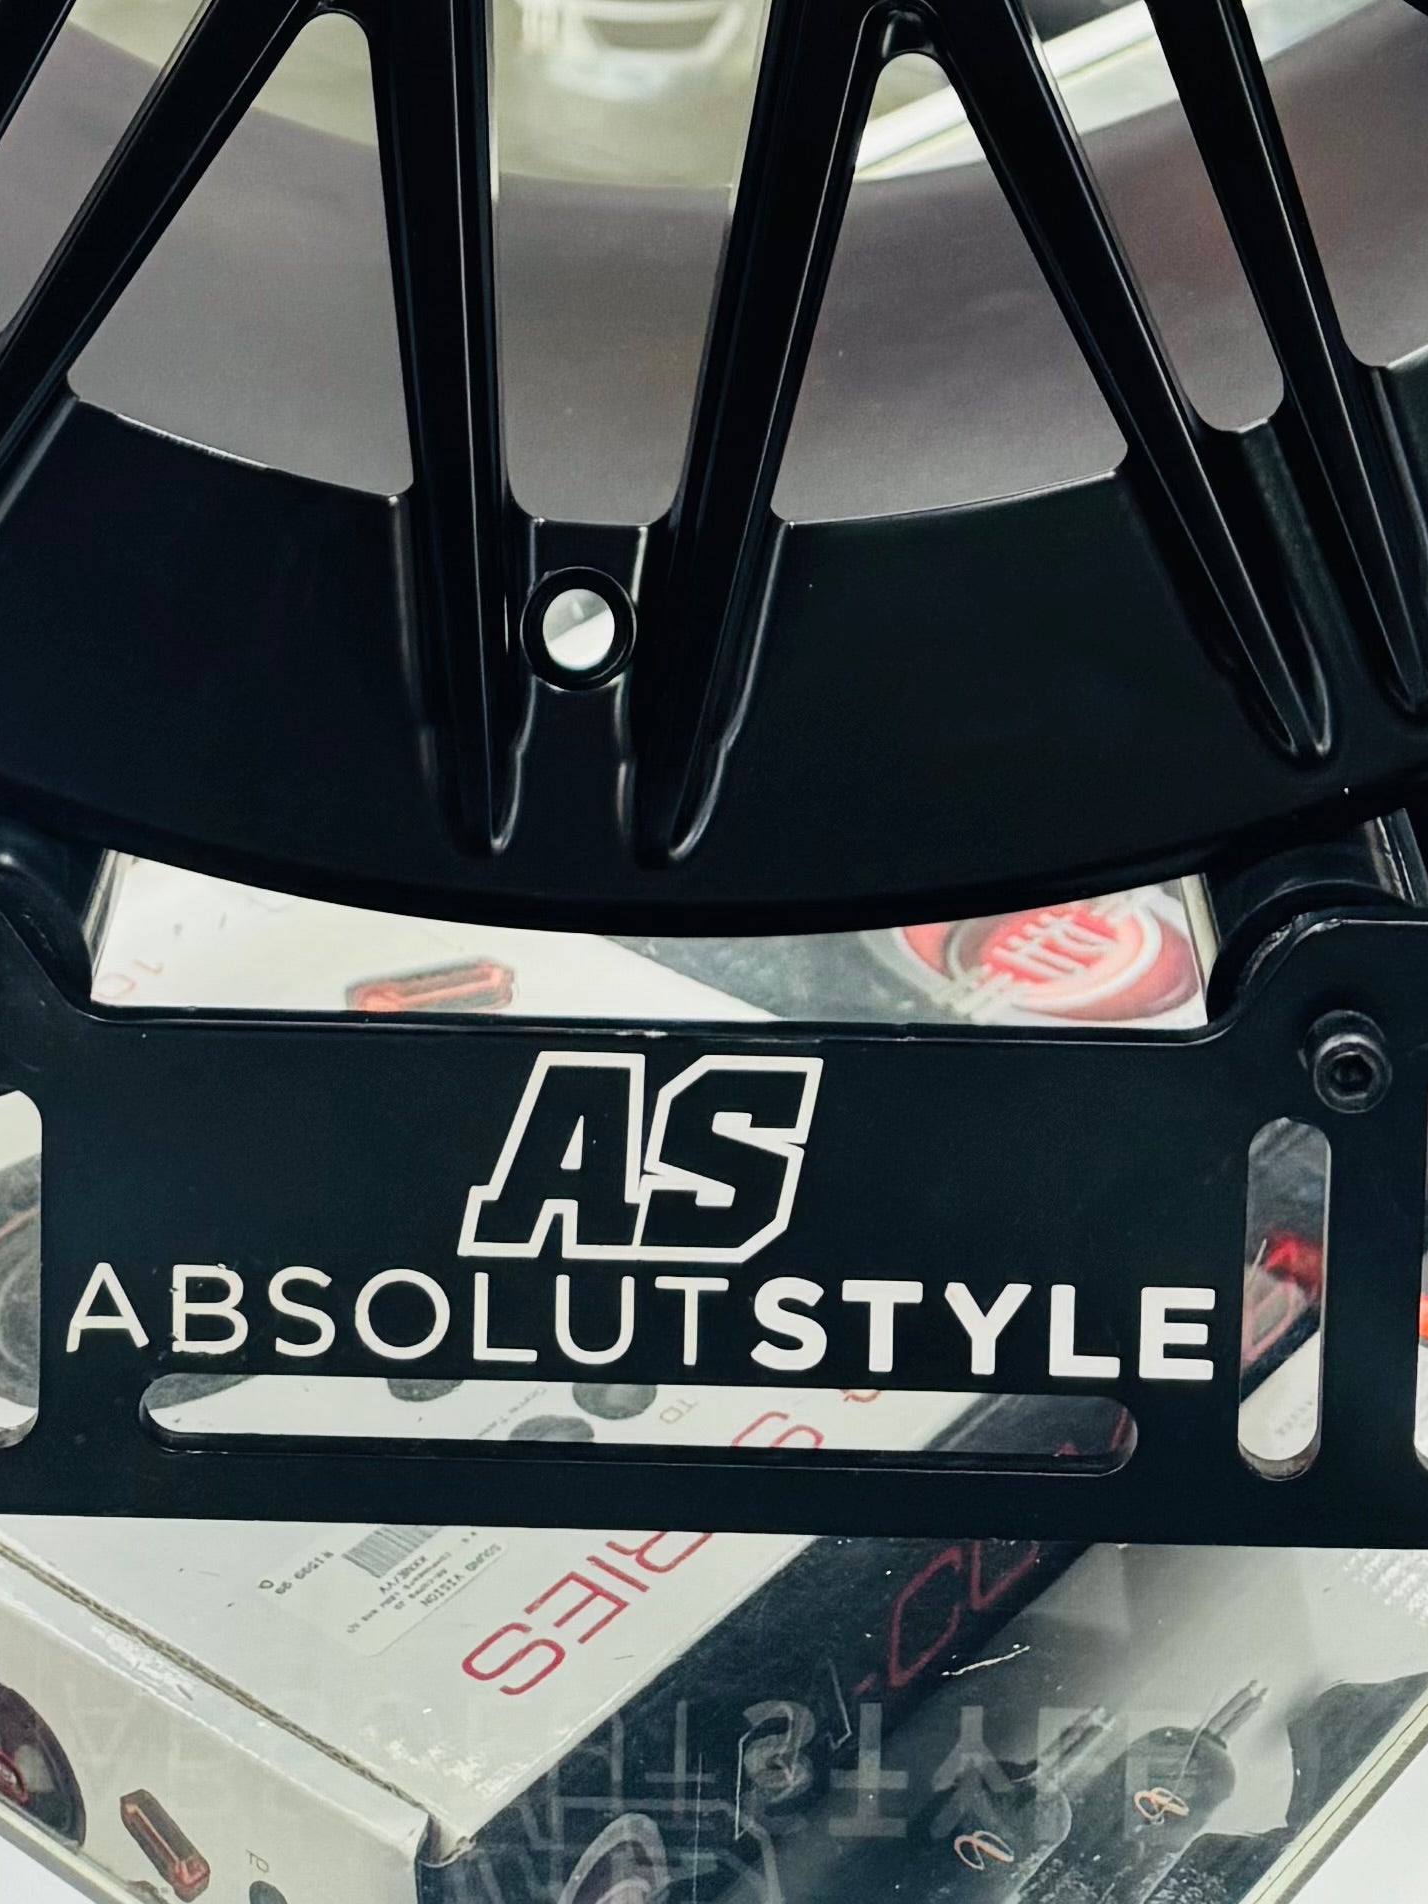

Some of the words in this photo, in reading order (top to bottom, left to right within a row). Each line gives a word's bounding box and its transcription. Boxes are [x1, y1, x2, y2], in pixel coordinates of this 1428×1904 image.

[457, 1050, 824, 1263] AS
[64, 1259, 1217, 1381] ABSOLUTSTYLE
[460, 1410, 825, 1697] SRIES
